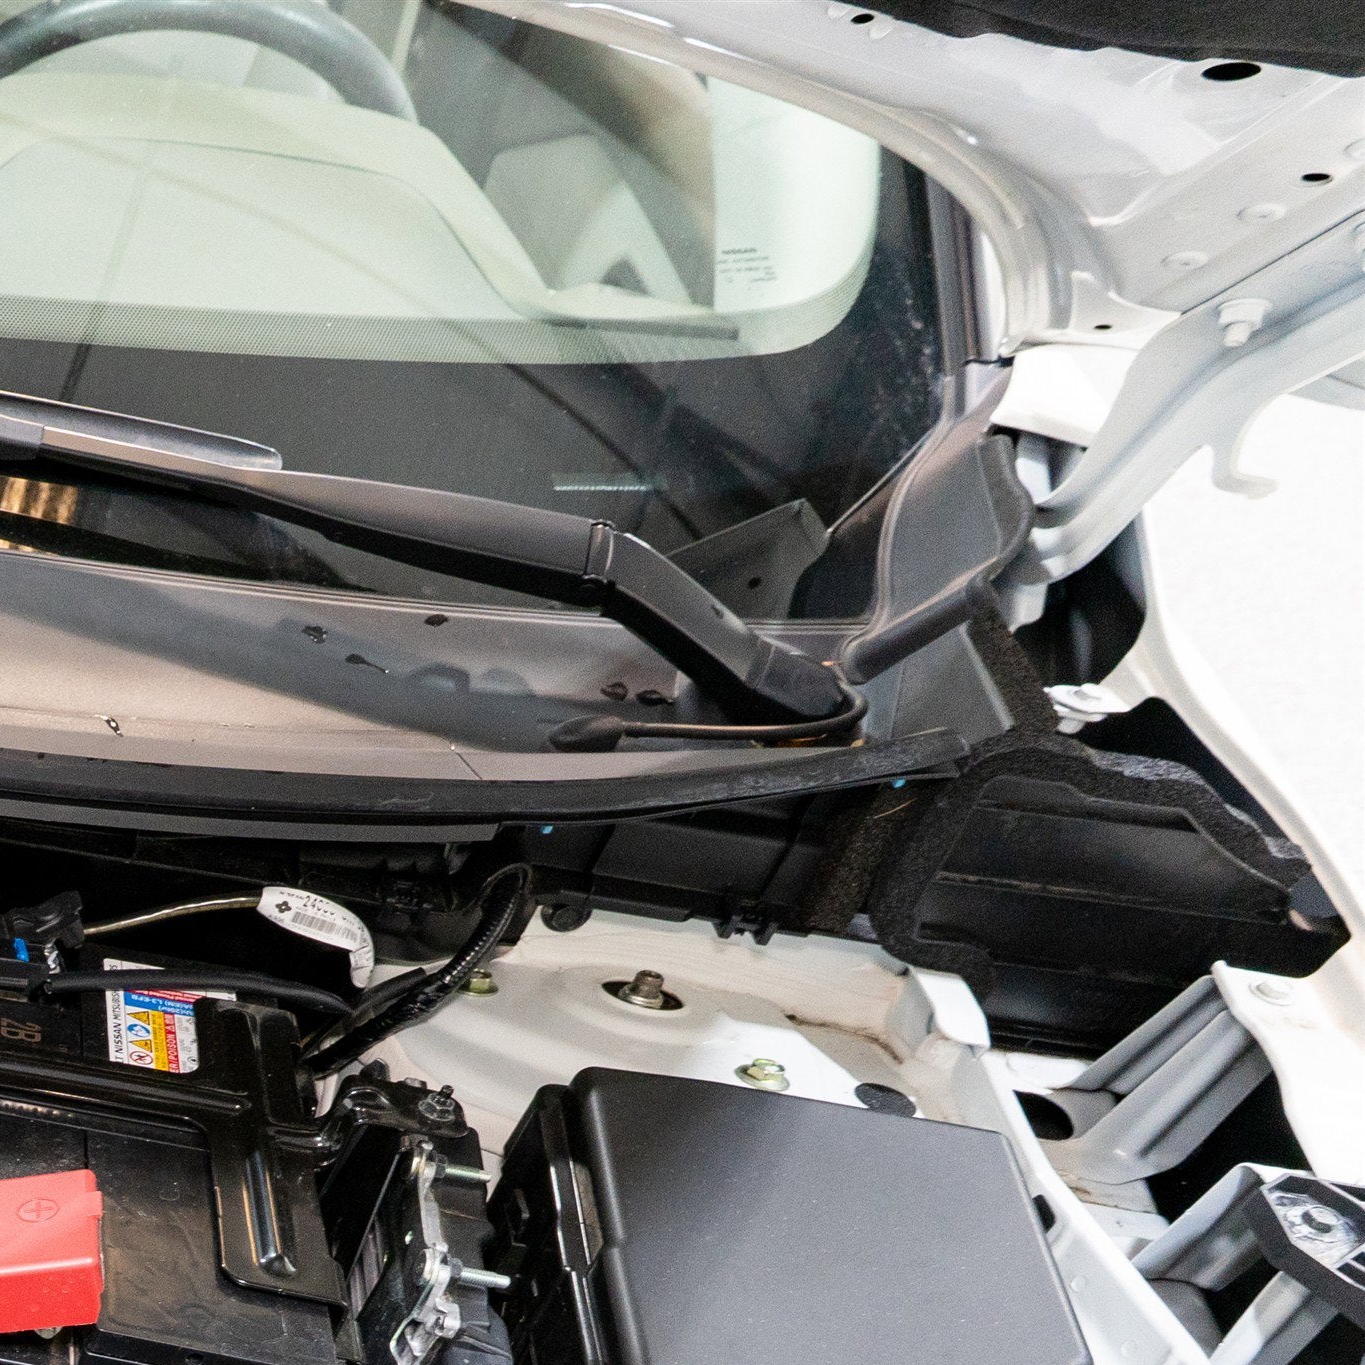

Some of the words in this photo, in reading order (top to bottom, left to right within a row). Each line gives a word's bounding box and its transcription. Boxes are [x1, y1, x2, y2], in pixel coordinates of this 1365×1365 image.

[0, 1017, 41, 1042] 2B
[113, 1022, 123, 1054] NISSAN
[166, 1034, 179, 1073] ER/POISON
